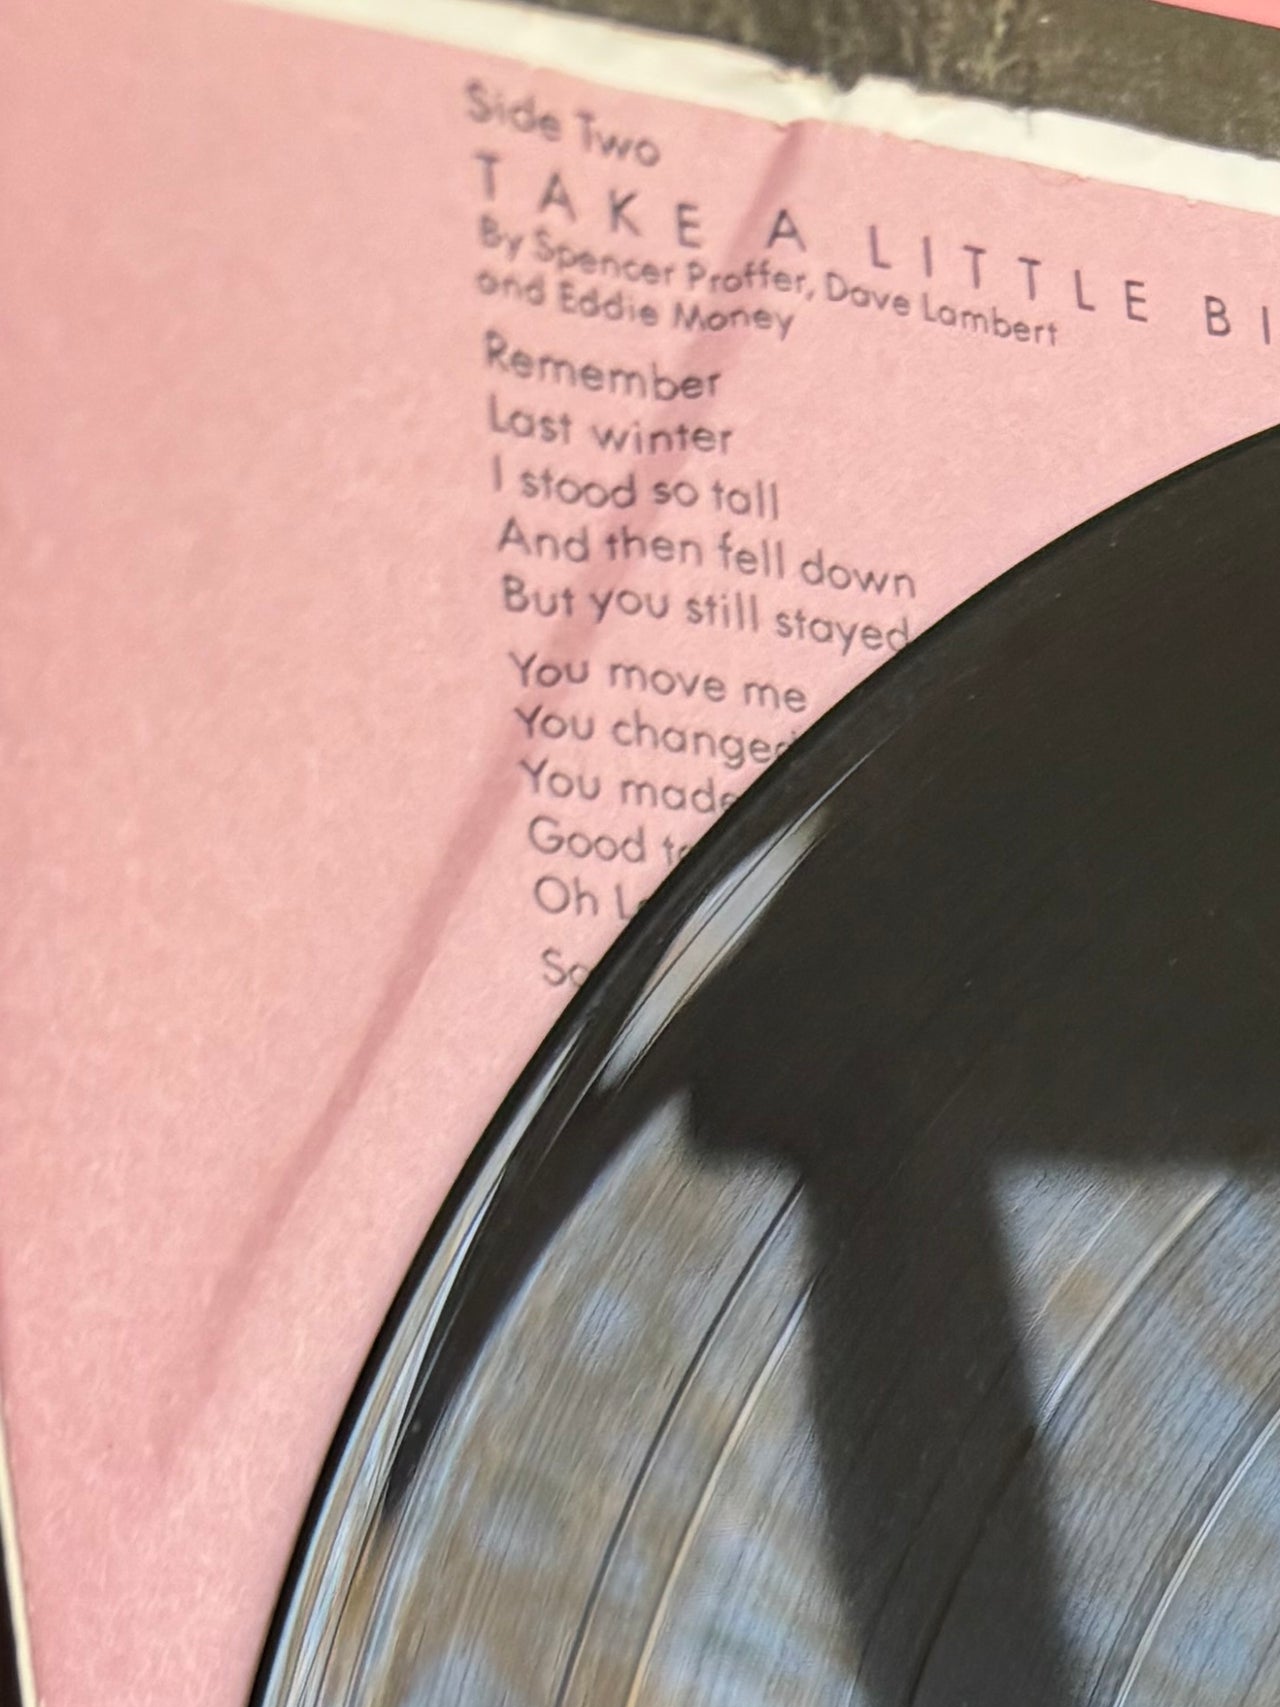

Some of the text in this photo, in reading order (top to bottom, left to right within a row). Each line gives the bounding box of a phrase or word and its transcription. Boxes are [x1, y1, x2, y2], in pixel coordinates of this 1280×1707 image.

[463, 80, 661, 168] Side Two
[474, 153, 702, 249] TAKE
[765, 209, 806, 252] A
[869, 224, 1148, 322] LITTLE
[475, 270, 795, 341] and Eddie Money
[477, 214, 1059, 348] By Spencer Proffer, Dave Lambert
[485, 329, 721, 401] Remember
[487, 394, 734, 456] Last winter
[493, 455, 779, 520] I stood so tall
[498, 515, 917, 600] And then fell down
[501, 575, 910, 657] But you still stayed
[508, 650, 808, 713] You move me
[514, 704, 594, 740] You
[520, 759, 600, 800] You
[528, 815, 646, 864] Good
